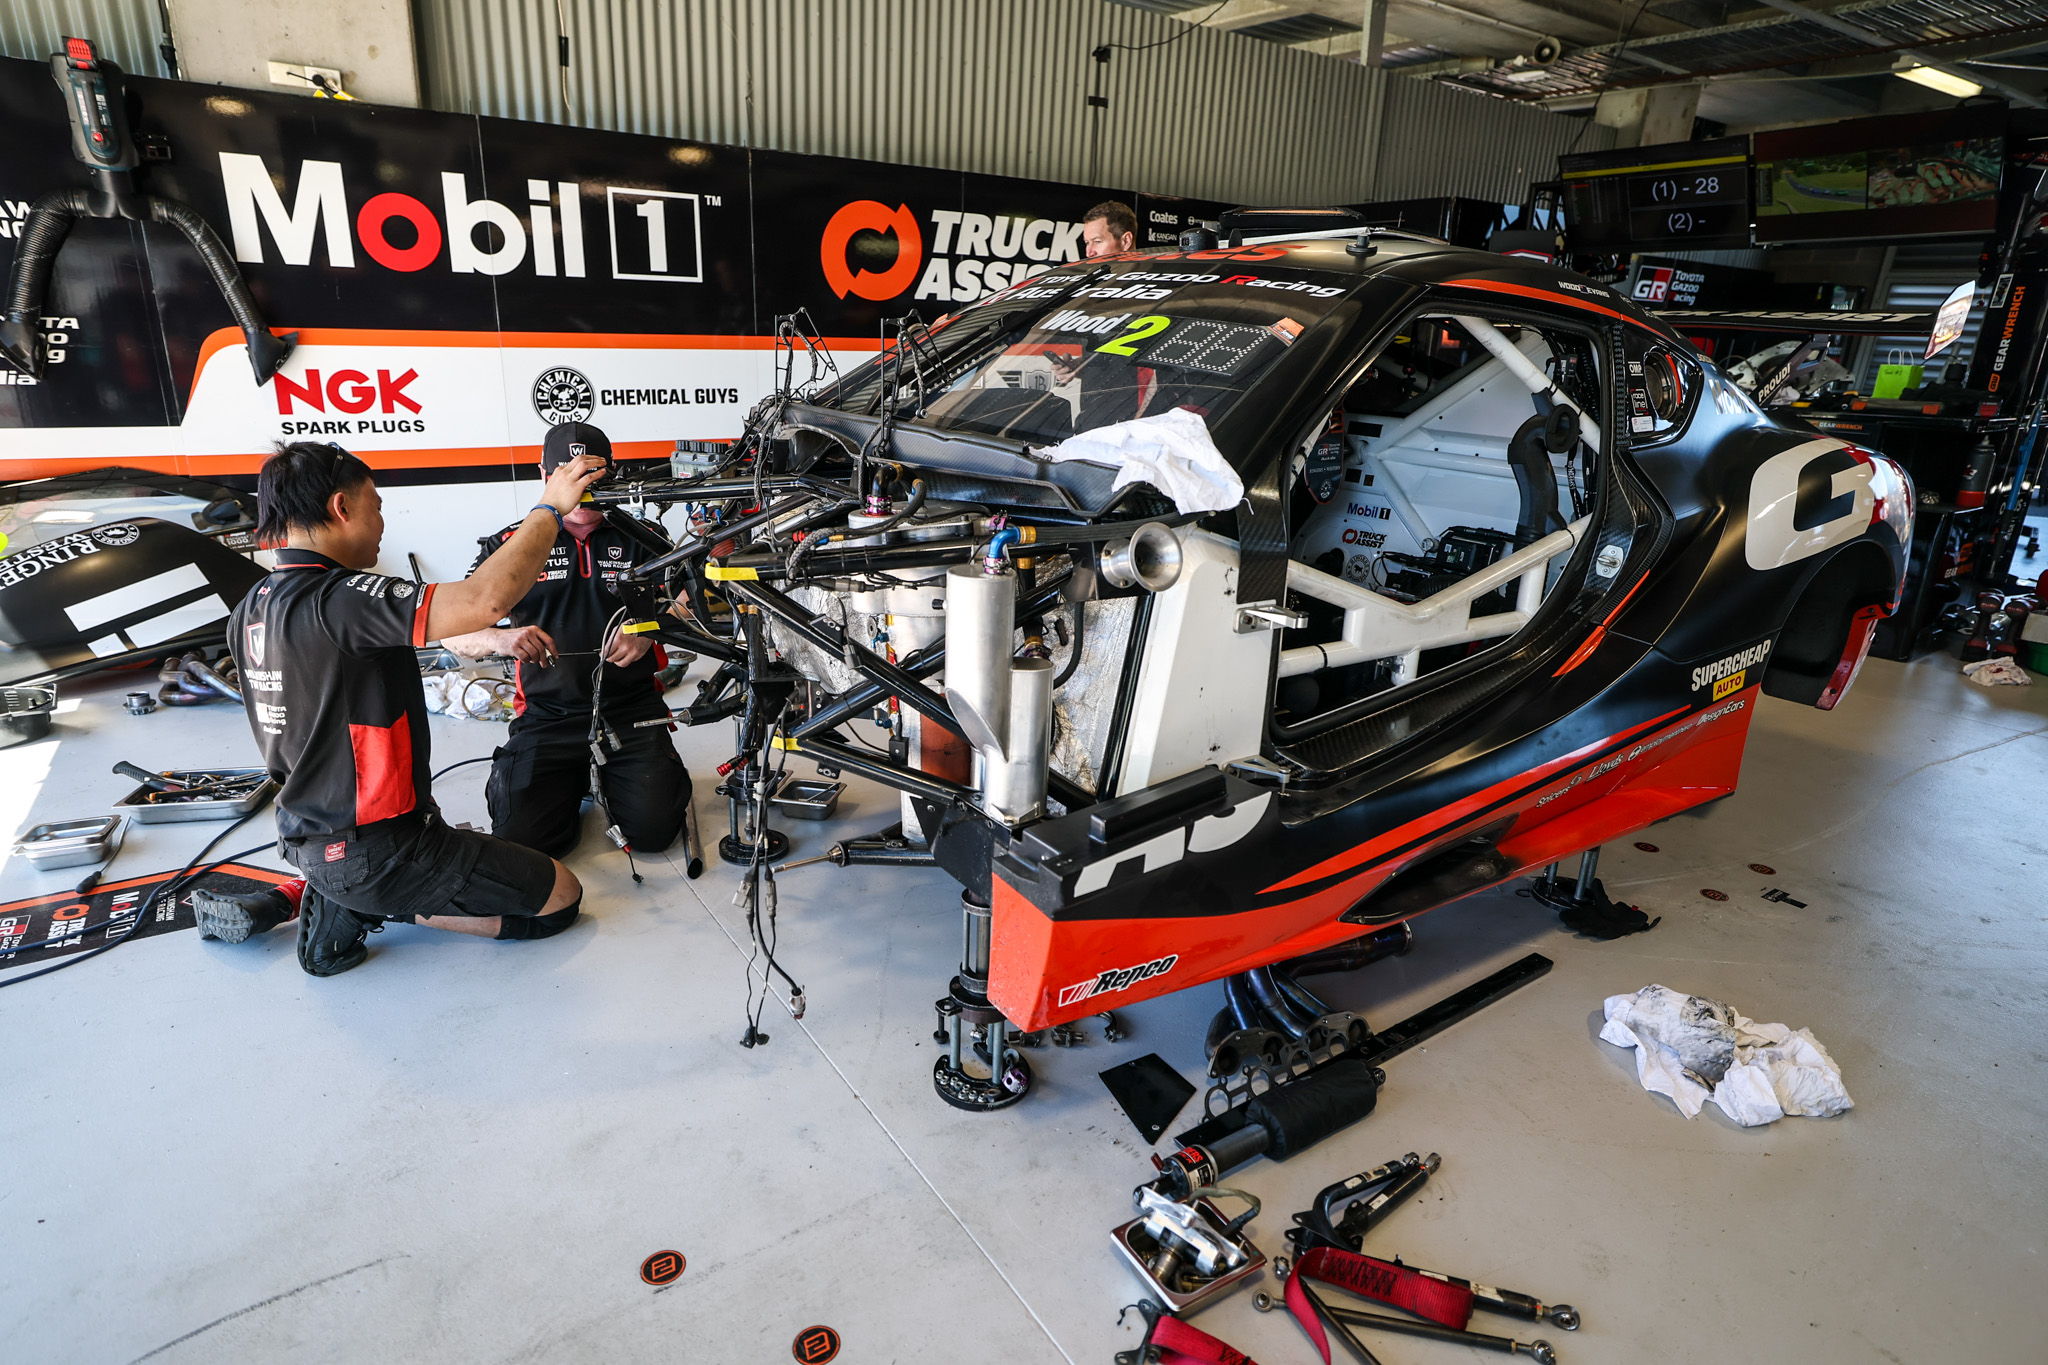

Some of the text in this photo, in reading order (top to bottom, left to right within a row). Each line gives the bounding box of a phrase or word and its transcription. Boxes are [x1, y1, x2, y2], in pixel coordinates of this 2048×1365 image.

[1652, 179, 1677, 201] (1)
[1695, 177, 1719, 195] 28
[219, 152, 586, 278] Mobil
[1149, 210, 1179, 225] Coates
[1668, 212, 1693, 232] (2)
[931, 209, 1085, 262] TRUCK
[1156, 232, 1178, 241] KANGAN
[1116, 271, 1220, 284] GAZOO
[1219, 274, 1346, 298] Racing
[1675, 270, 1705, 283] TOYOTA
[1558, 281, 1581, 292] WOOD
[1635, 280, 1667, 299] GR
[1671, 281, 1700, 293] GAZOO
[1040, 309, 1172, 357] Wood 2
[1993, 286, 2026, 372] GEARWRENCH
[1628, 364, 1643, 374] OMP
[273, 367, 423, 415] NGK
[537, 371, 591, 401] CHEMICAL
[601, 387, 739, 406] CHEMICAL GUYS
[281, 419, 426, 435] SPARK PLUGS
[1819, 422, 1863, 430] GEARWRENCH
[1347, 503, 1379, 518] Mobil
[1354, 538, 1385, 549] ASSIST
[1359, 531, 1387, 542] TRUCK
[1691, 639, 1772, 692] SUPERCHEAP
[1715, 675, 1743, 696] AUTO
[1090, 955, 1178, 996] Repco
